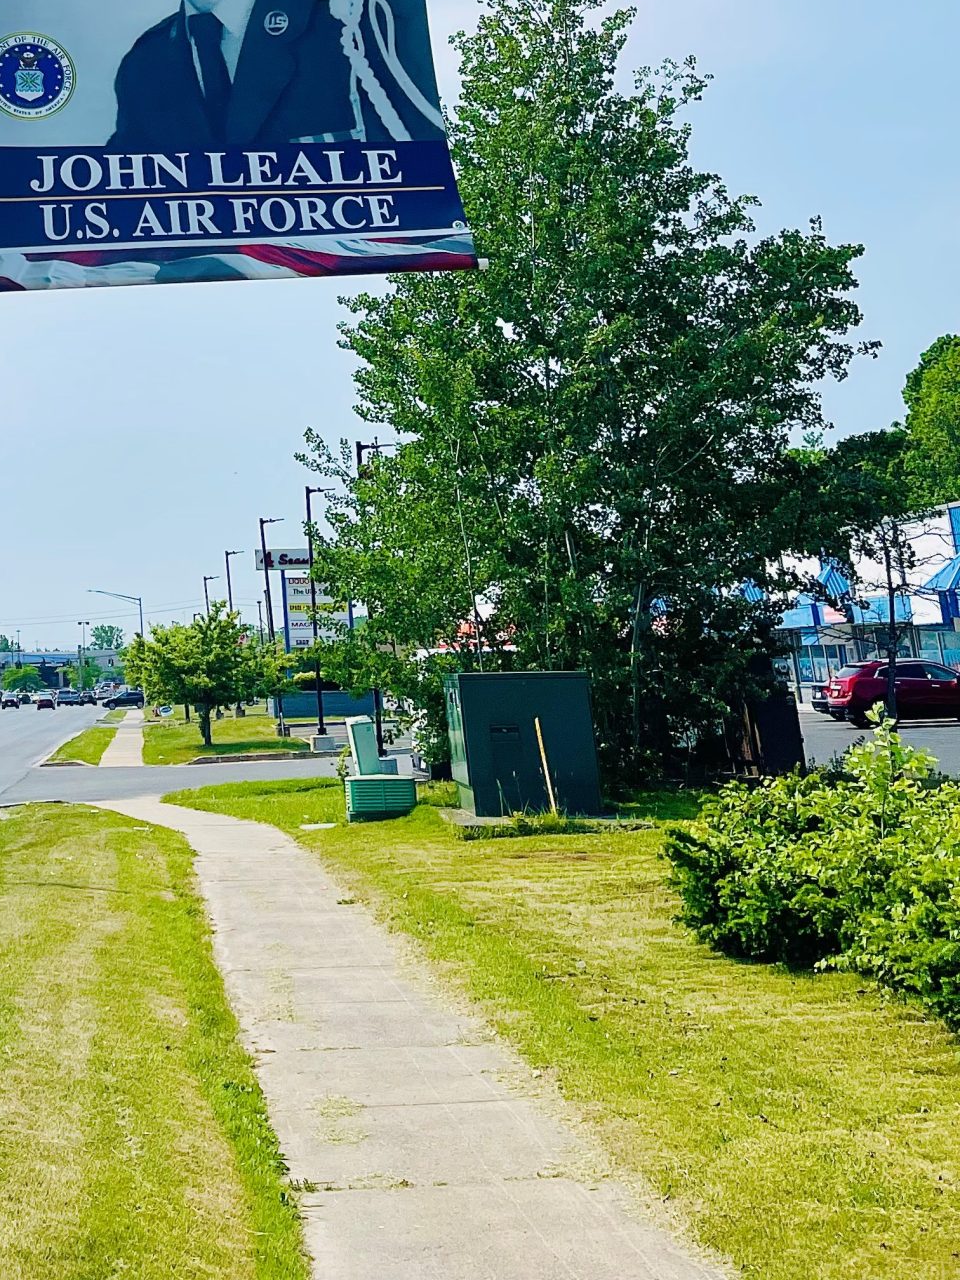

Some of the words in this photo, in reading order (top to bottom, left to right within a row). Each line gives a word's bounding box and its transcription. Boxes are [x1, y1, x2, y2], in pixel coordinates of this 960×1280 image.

[32, 36, 50, 46] THE
[52, 48, 66, 61] AIR
[63, 64, 72, 91] FORCE
[29, 152, 190, 192] JOHN
[204, 150, 402, 186] LEALE
[39, 202, 120, 241] U.S.
[132, 199, 222, 236] AIR
[228, 194, 400, 233] FORCE
